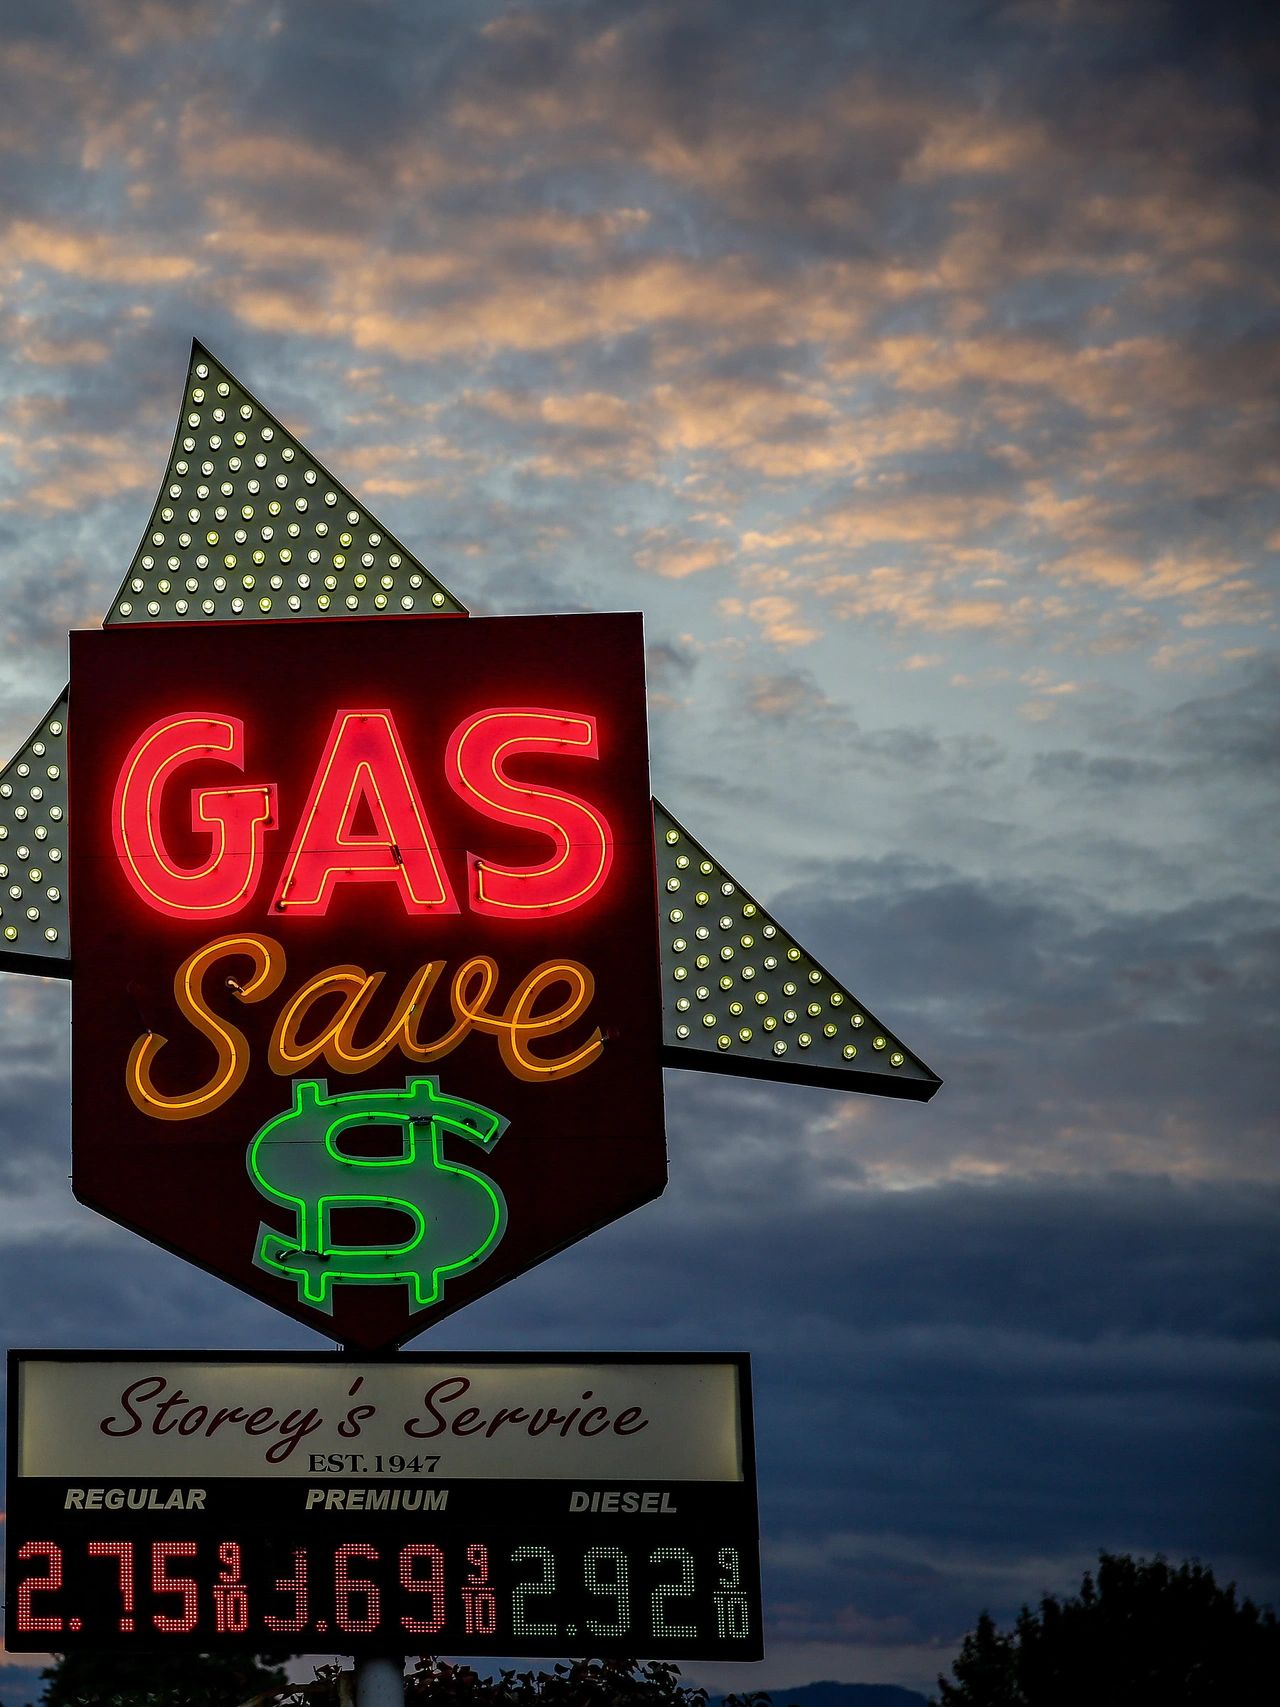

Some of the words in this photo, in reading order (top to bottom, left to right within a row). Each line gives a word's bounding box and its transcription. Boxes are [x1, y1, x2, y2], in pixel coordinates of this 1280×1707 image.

[112, 708, 615, 920] GAS
[125, 933, 604, 1121] Save
[246, 1075, 512, 1317] $
[99, 1375, 376, 1464] Storey's
[403, 1375, 650, 1439] Service
[63, 1488, 207, 1510] REGULAR
[304, 1488, 450, 1511] PREMIUM
[568, 1490, 678, 1514] DIESEL
[17, 1540, 199, 1632] 2.75
[510, 1545, 698, 1638] 2.92
